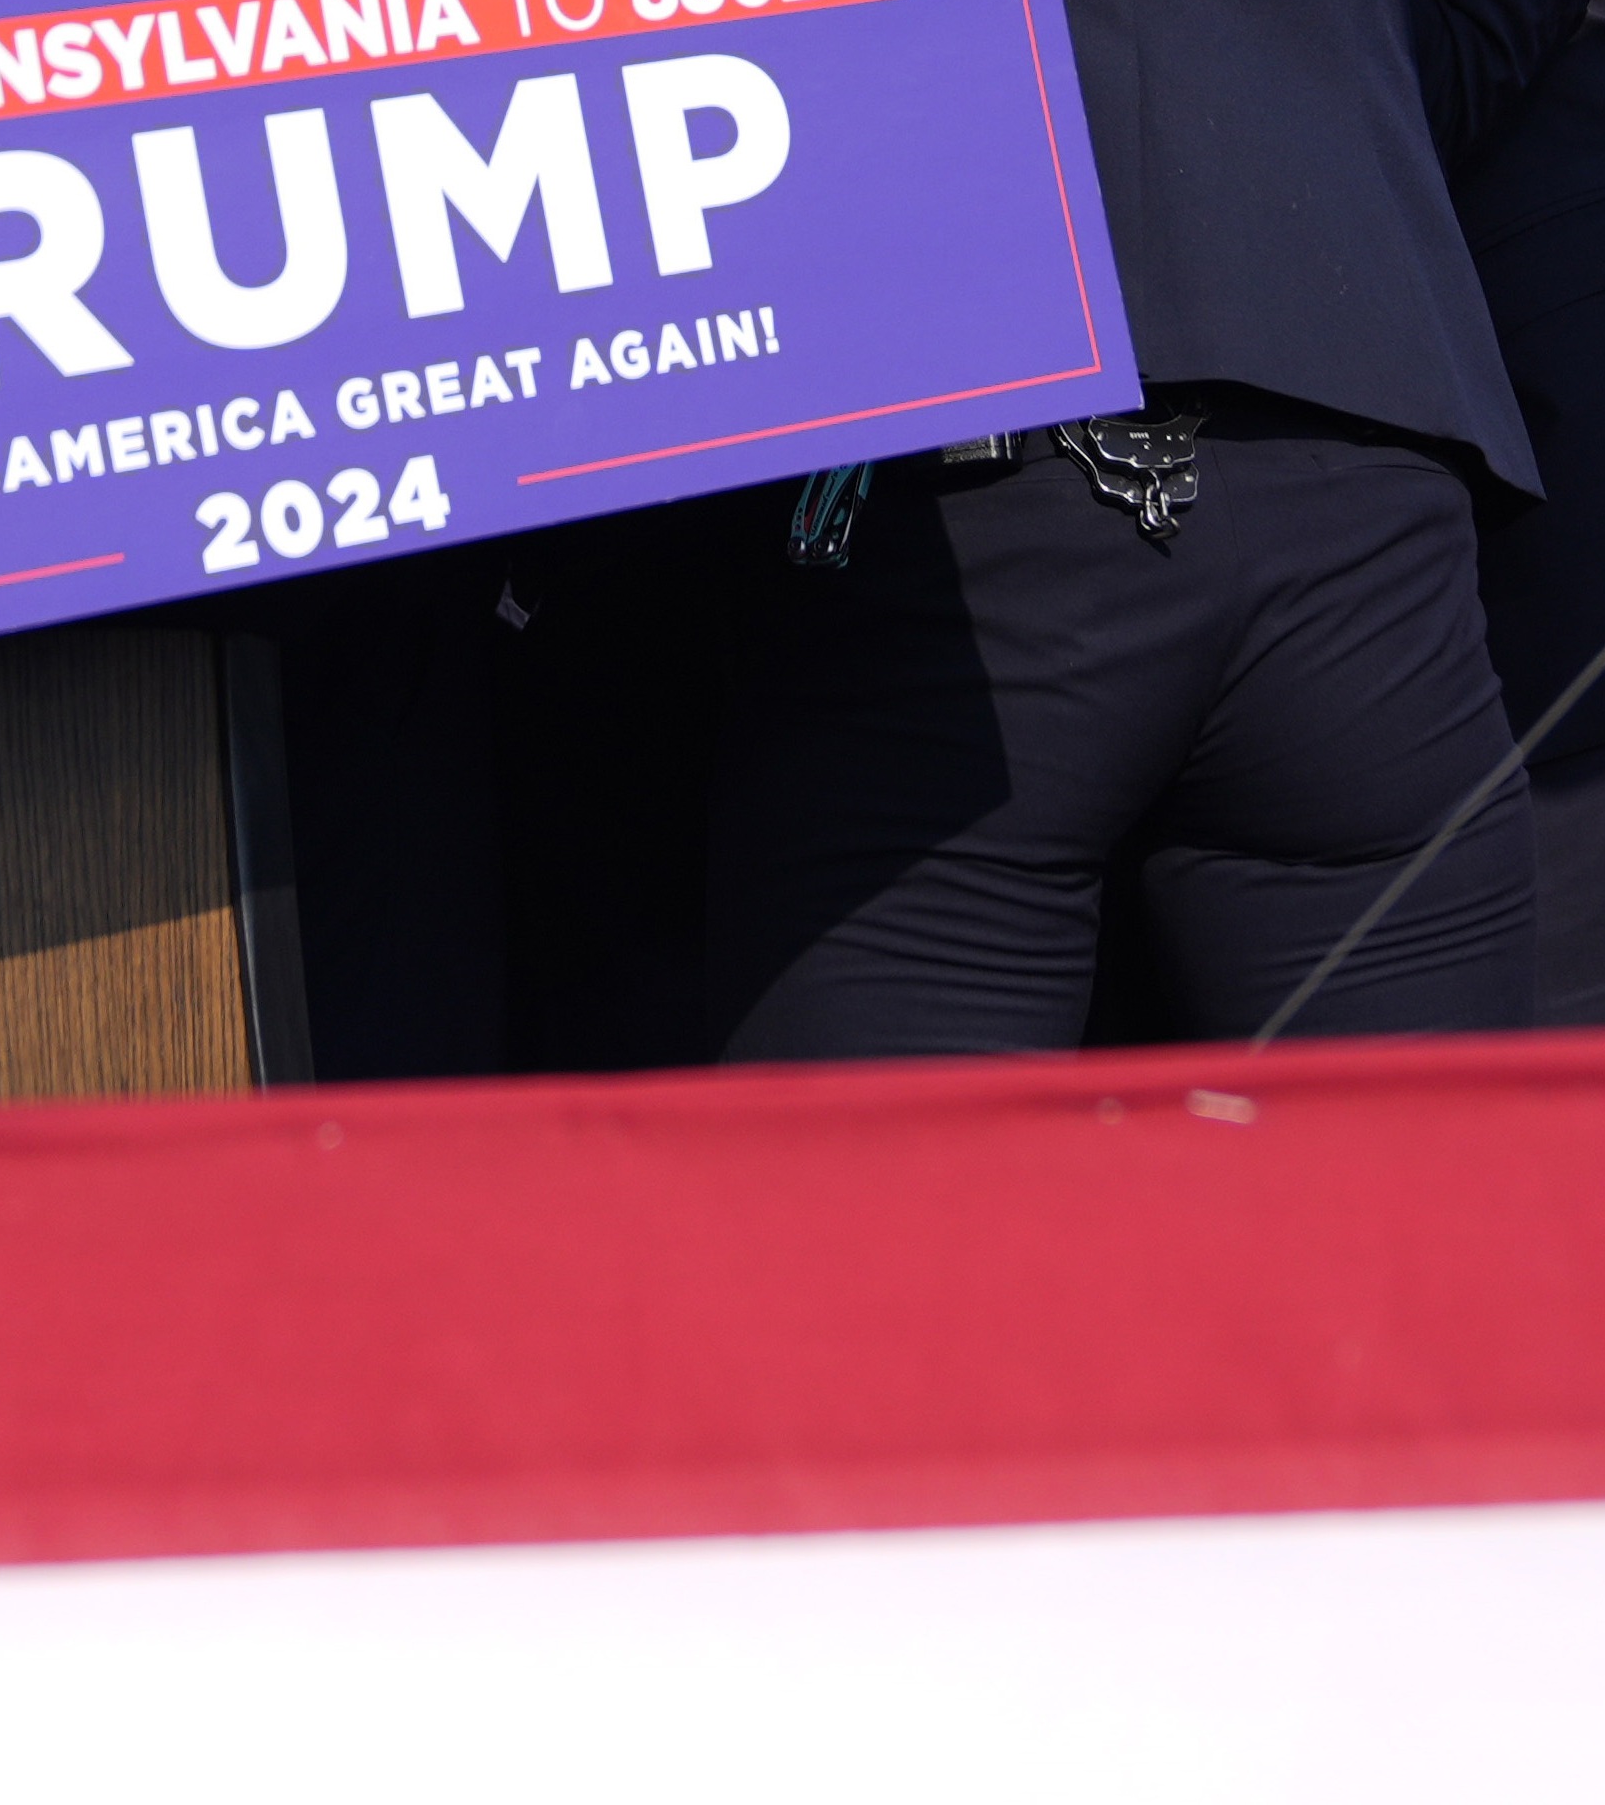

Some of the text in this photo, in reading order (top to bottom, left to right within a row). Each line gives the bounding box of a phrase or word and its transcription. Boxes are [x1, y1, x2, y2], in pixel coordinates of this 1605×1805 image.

[3, 389, 316, 493] AMERICA
[336, 347, 543, 430] GREAT
[570, 306, 780, 390] AGAIN!
[195, 454, 451, 563] 2024
